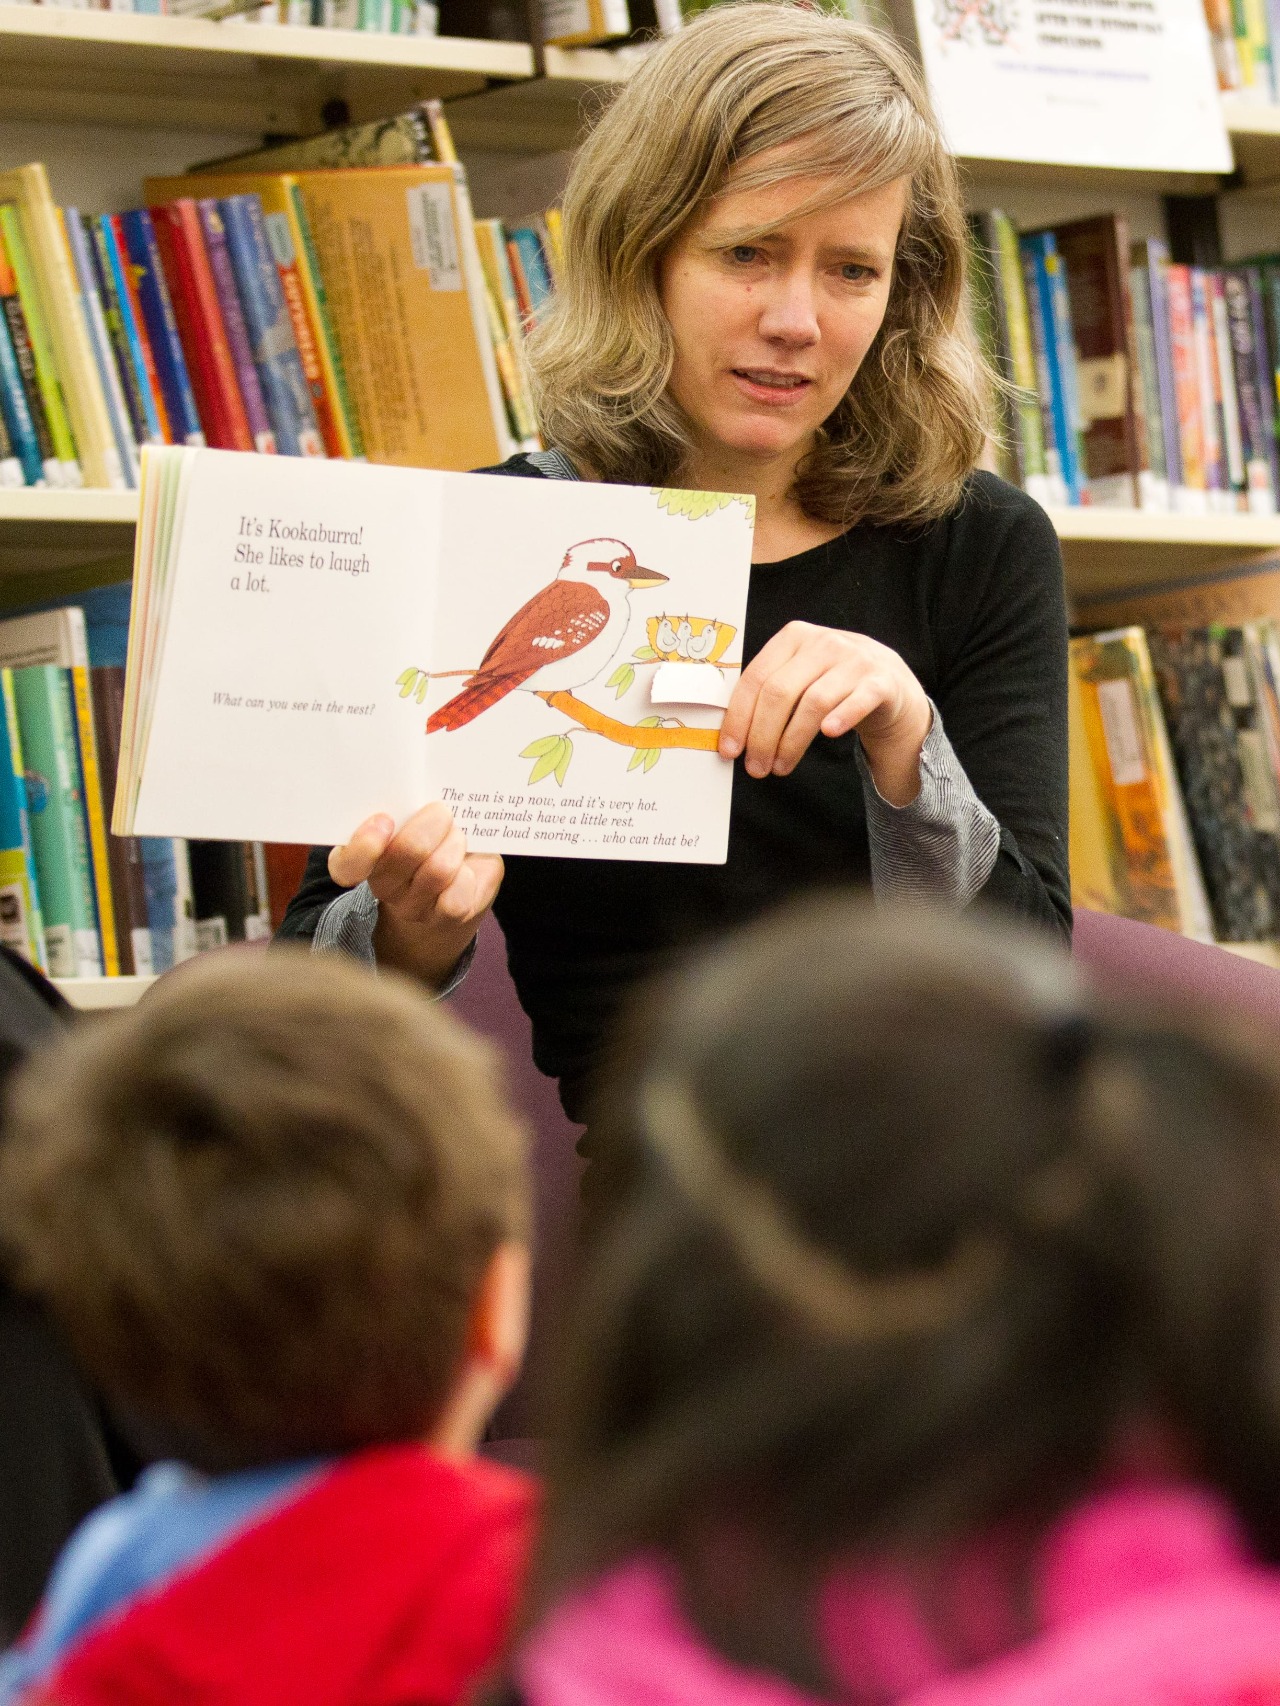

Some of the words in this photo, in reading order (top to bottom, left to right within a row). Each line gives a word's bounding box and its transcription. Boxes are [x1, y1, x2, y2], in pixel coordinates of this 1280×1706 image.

[238, 515, 263, 537] It's
[268, 518, 364, 546] Kookaburra!
[234, 543, 264, 565] She
[268, 545, 305, 568] likes
[309, 552, 325, 570] to
[328, 550, 370, 577] laugh
[230, 576, 241, 591] a
[245, 571, 270, 593] lot.
[213, 691, 243, 707] What
[244, 698, 265, 709] can
[266, 699, 289, 713] you
[291, 701, 309, 712] see
[311, 699, 323, 712] in
[325, 700, 344, 714] the
[346, 703, 376, 716] nest?
[442, 787, 465, 802] The
[467, 793, 490, 803] sun
[493, 790, 505, 804] is
[507, 795, 524, 808] up
[527, 796, 556, 808] now,
[560, 795, 585, 808] and
[586, 795, 606, 809] it's
[609, 800, 635, 814] very
[636, 797, 658, 812] hot.
[461, 805, 481, 820] the
[483, 805, 534, 823] animals
[536, 809, 567, 825] have
[569, 815, 577, 825] a
[580, 812, 608, 827] little
[610, 816, 634, 828] rest.
[471, 823, 500, 837] hear
[502, 825, 531, 840] loud
[533, 828, 581, 845] snoring
[602, 831, 627, 845] who
[629, 835, 649, 845] can
[652, 832, 677, 847] that
[680, 833, 700, 847] be?
